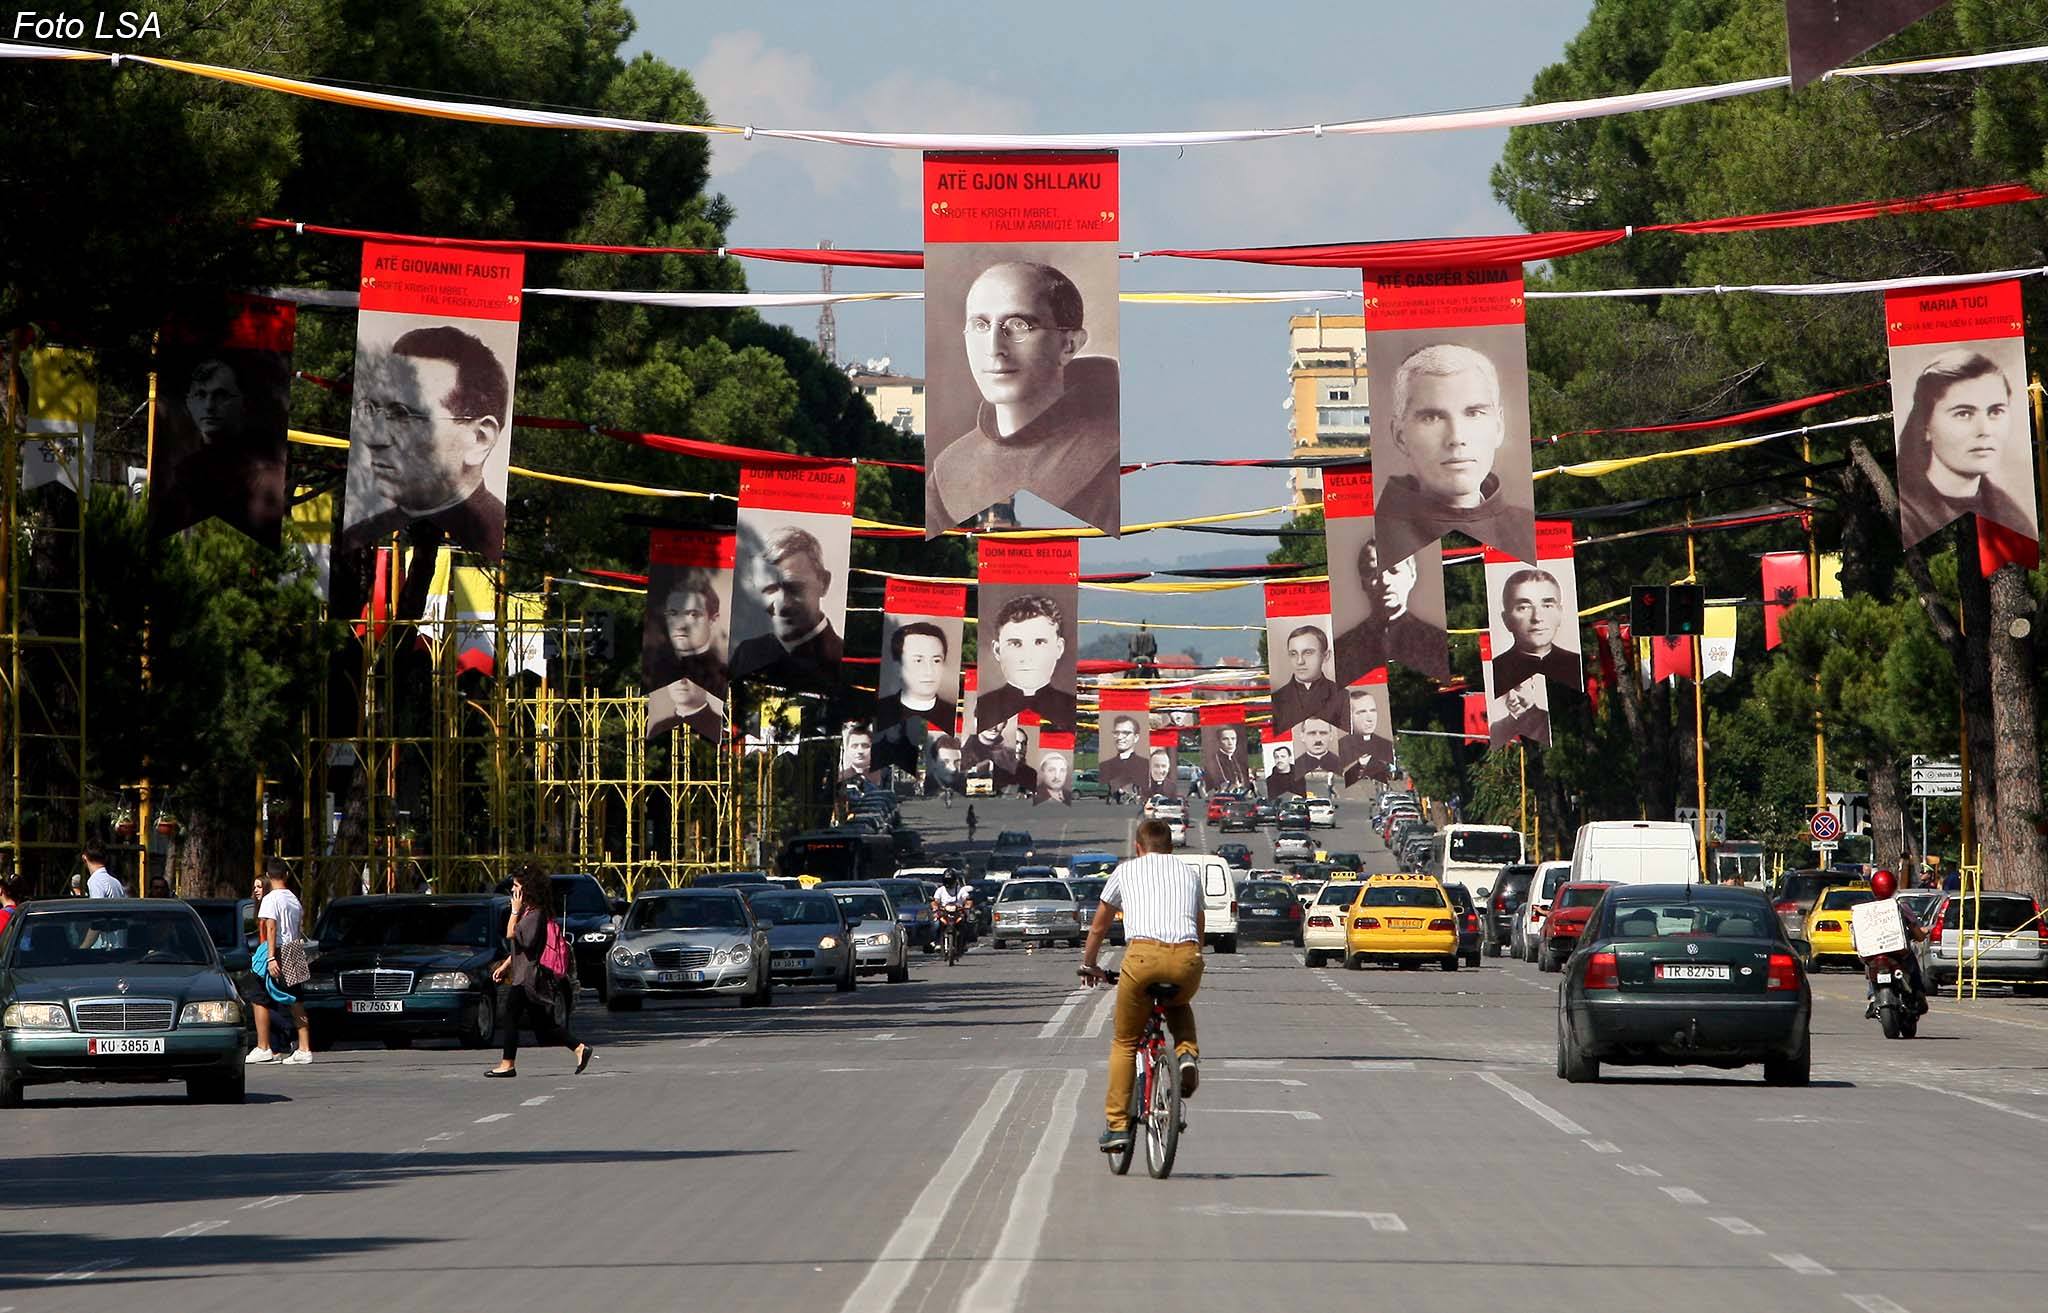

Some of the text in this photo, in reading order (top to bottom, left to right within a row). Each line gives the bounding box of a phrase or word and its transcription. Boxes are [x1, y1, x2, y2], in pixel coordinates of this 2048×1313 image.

[937, 170, 1101, 190] ATË GJON SHLLAKU
[980, 207, 1021, 219] KRISHTI
[996, 220, 1025, 231] FALIM
[375, 256, 511, 279] ATË GIOVANNI FAUSTI
[1377, 271, 1402, 289] ATË
[1466, 269, 1509, 285] SUMA
[1919, 295, 1988, 312] MARIA TUCI
[750, 467, 775, 479] DOM
[807, 471, 846, 484] ZADEJA
[984, 547, 1073, 558] DOM MIKEL BELTOJA
[1453, 838, 1464, 847] 24
[1668, 966, 1725, 977] TR 8275 L
[355, 1001, 366, 1011] TR
[101, 1040, 161, 1052] KU 3855 A
